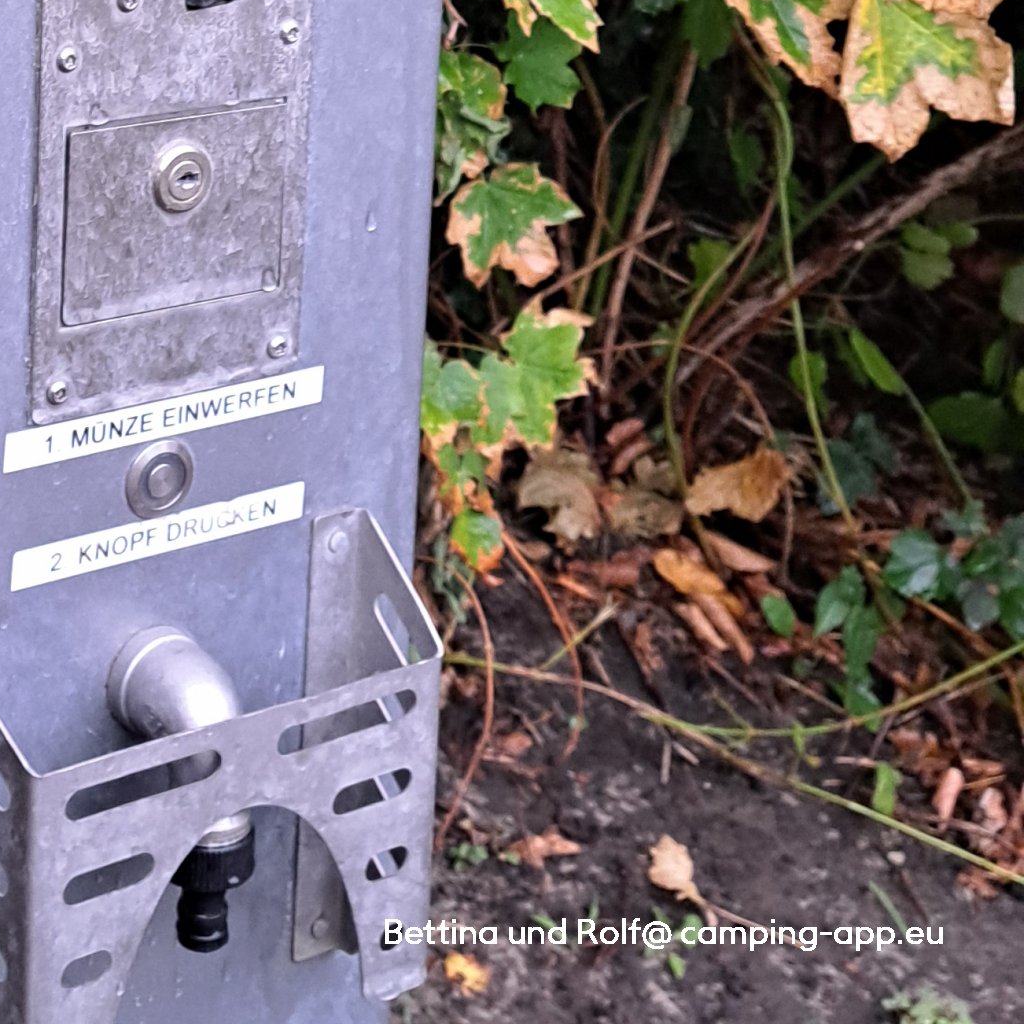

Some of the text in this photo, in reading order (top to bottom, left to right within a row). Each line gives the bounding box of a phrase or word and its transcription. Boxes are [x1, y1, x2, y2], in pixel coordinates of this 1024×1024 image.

[45, 435, 53, 454] 1
[162, 381, 297, 428] EINWERFEN
[50, 551, 63, 573] 2
[78, 526, 158, 565] KNOPF
